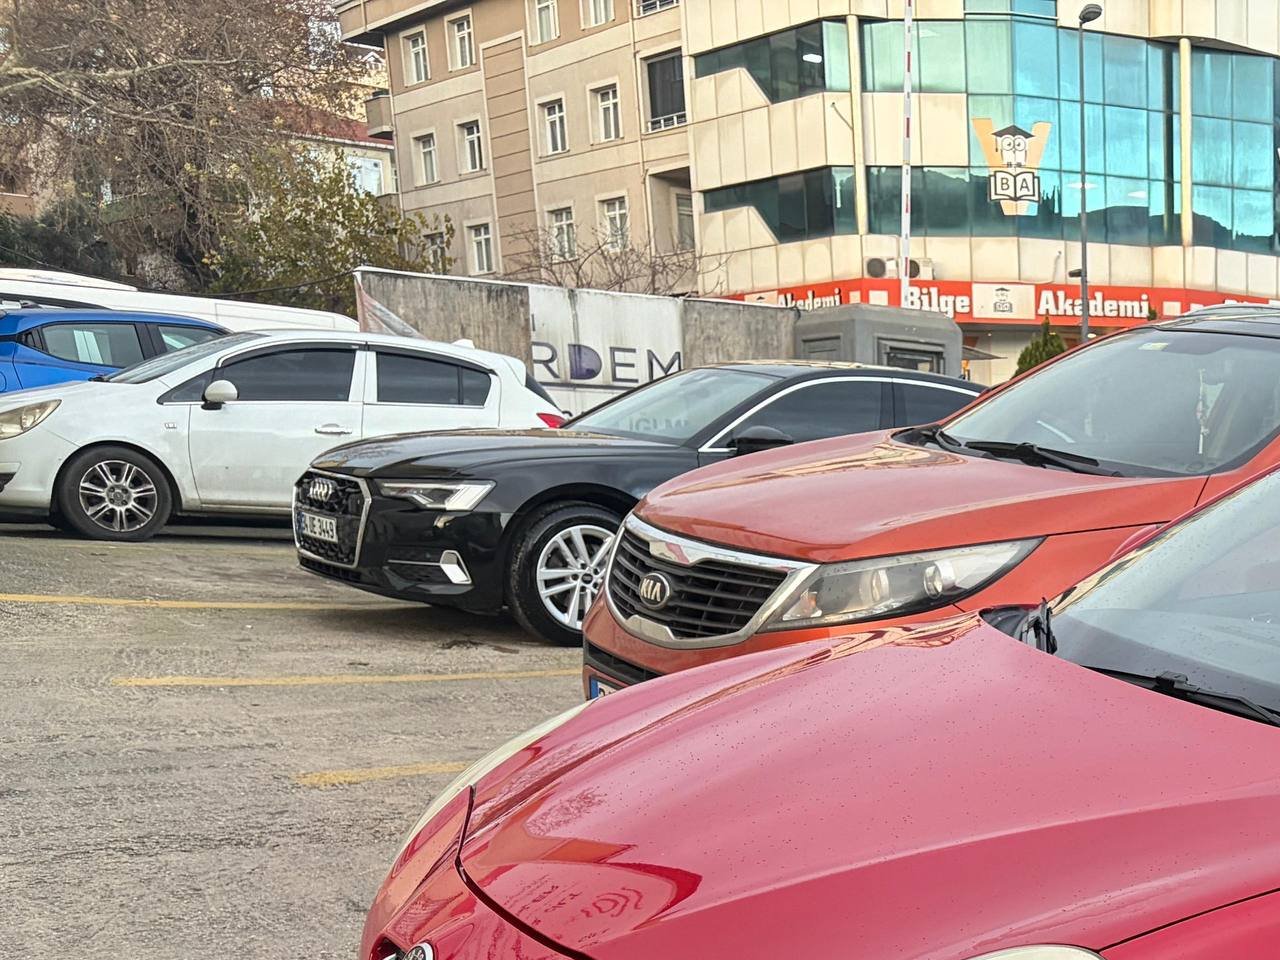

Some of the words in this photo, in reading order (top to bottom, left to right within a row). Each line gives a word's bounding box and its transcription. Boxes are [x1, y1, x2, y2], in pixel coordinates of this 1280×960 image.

[1000, 177, 1010, 191] B
[1019, 178, 1030, 192] A
[902, 286, 970, 317] Bilge
[1038, 290, 1149, 318] Akademi
[639, 579, 661, 602] KIA
